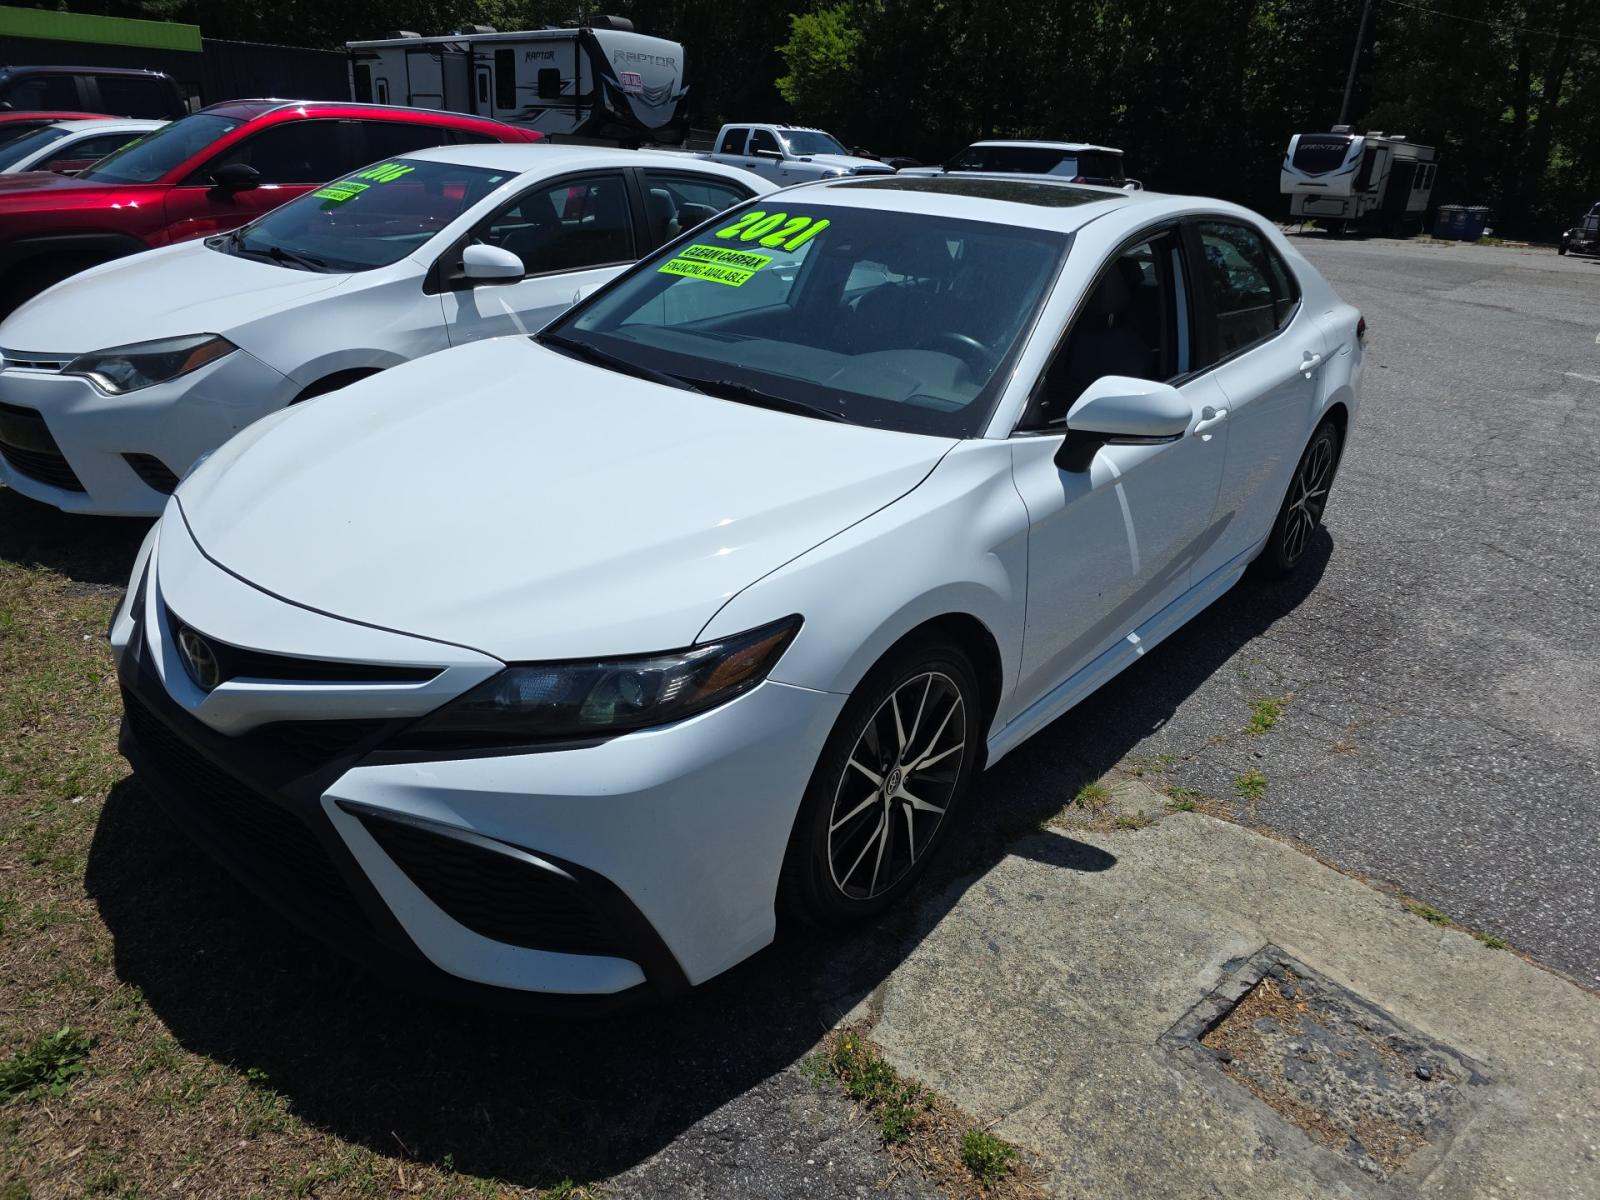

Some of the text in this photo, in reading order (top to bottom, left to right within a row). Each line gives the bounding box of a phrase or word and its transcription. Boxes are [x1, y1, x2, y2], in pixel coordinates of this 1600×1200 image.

[525, 49, 555, 63] RAPTOR
[613, 49, 678, 72] RAPTOR
[715, 211, 831, 252] 2021
[683, 247, 766, 268] CLEAN CARFAX
[666, 261, 748, 284] FINANCING AVAILABLE
